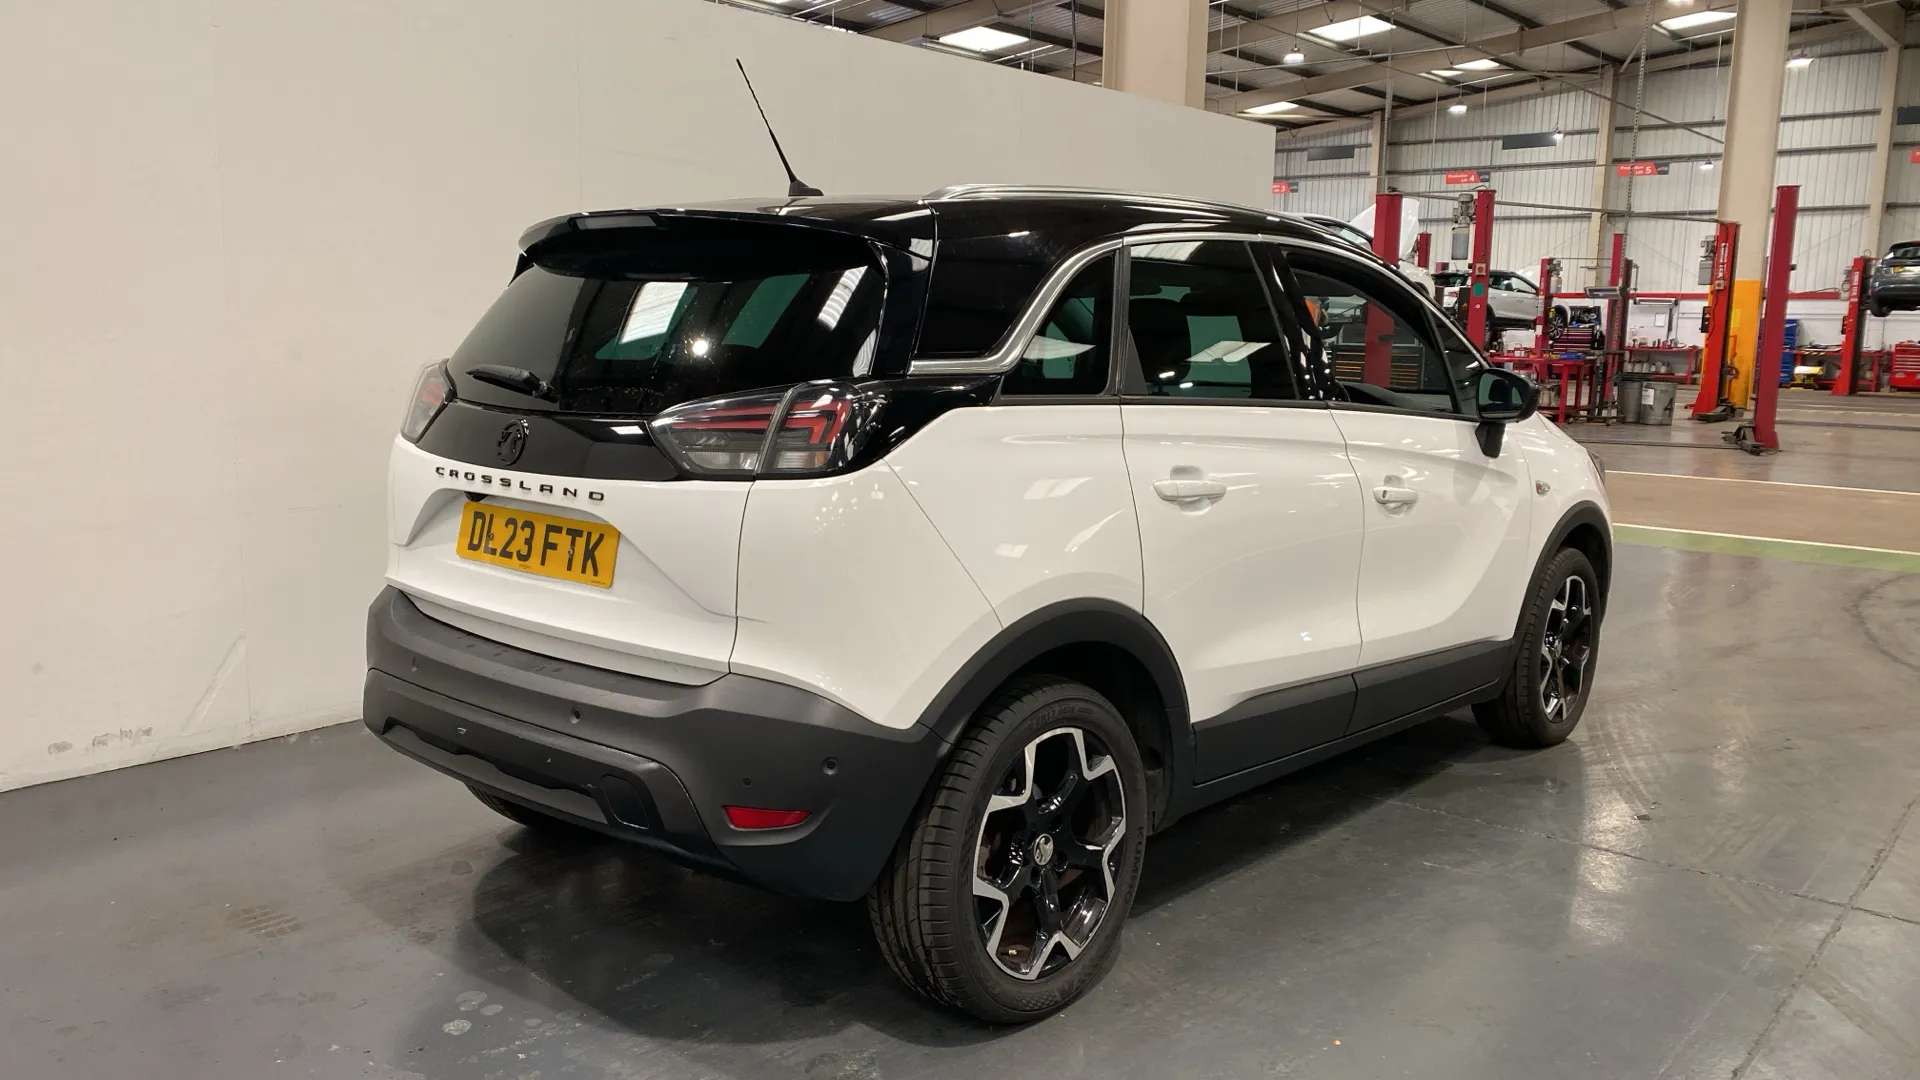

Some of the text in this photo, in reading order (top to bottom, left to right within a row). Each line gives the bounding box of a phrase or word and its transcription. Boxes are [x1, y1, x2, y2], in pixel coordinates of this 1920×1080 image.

[1645, 166, 1652, 174] 5
[435, 466, 605, 502] CROSSLAND
[467, 511, 605, 577] DL23 FTK
